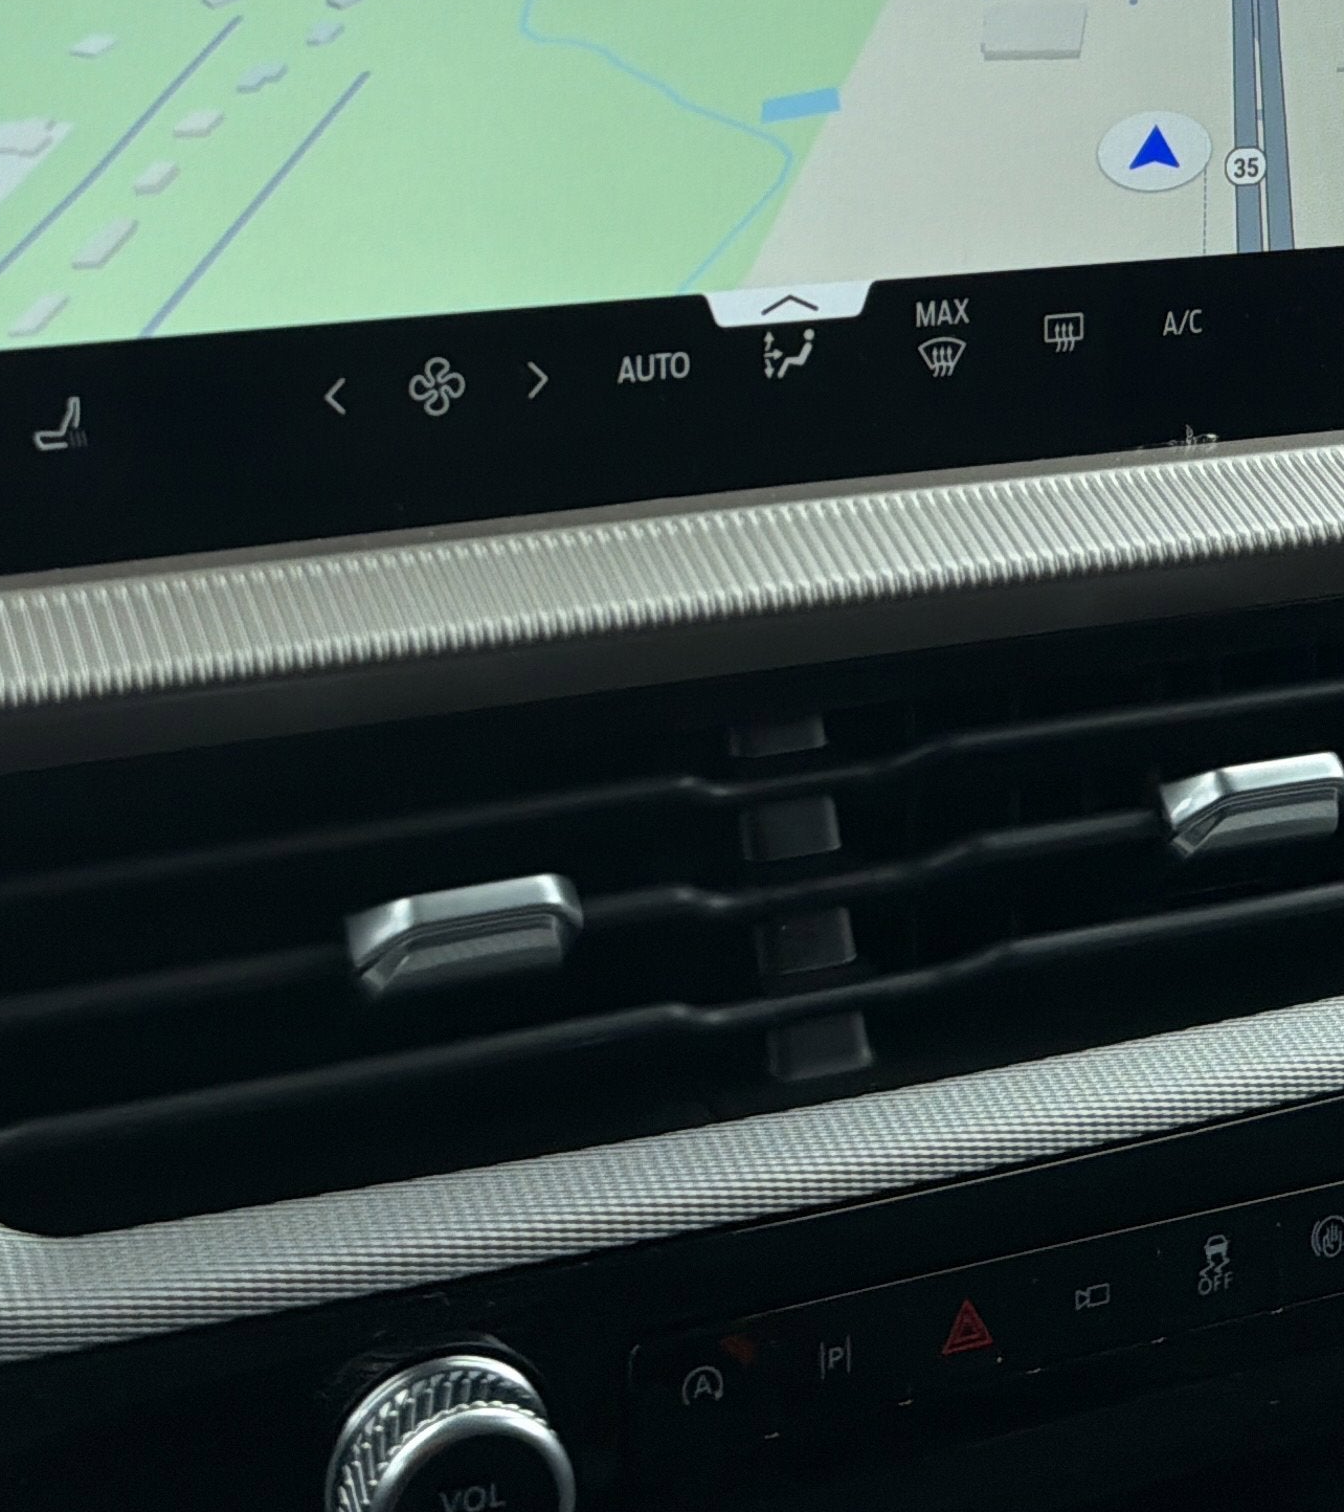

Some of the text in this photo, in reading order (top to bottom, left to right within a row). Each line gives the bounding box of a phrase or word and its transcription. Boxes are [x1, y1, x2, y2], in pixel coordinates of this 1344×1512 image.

[1233, 157, 1259, 178] 35
[915, 299, 970, 327] MAX
[1163, 309, 1203, 336] A/C
[617, 352, 691, 384] AUTO
[1197, 1271, 1235, 1295] OFF
[438, 1483, 507, 1512] VOL
